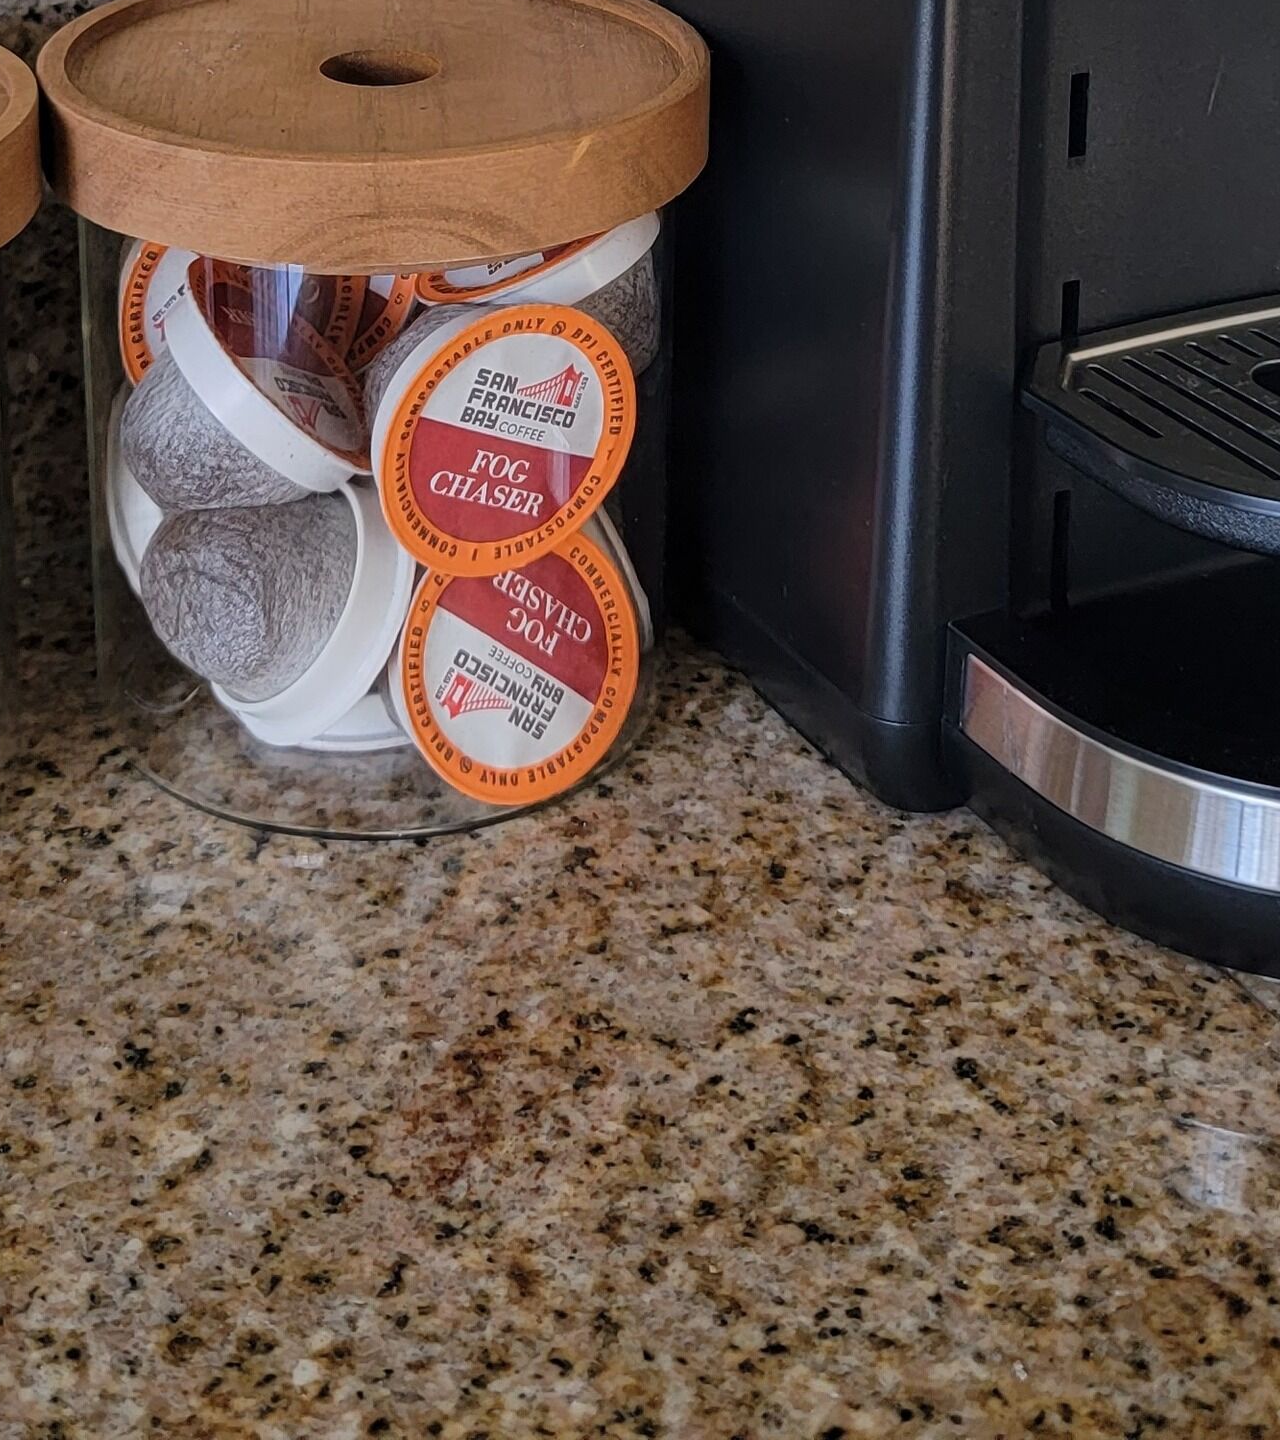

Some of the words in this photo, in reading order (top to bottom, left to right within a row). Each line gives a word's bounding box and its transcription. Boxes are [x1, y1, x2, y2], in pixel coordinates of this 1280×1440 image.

[129, 250, 158, 344] CERTIFIED
[502, 317, 545, 335] ONLY
[572, 327, 598, 350] BPI
[400, 328, 494, 441] COMPOSTABLE
[474, 368, 519, 394] SAN
[596, 350, 624, 436] CERTIFIED
[467, 388, 577, 429] FRANCISCO
[498, 421, 546, 442] COFFEE
[468, 449, 531, 484] FOG
[396, 452, 458, 558] COMMERCIALLY
[430, 470, 545, 518] CHASER
[494, 474, 602, 560] COMPOSTABLE
[492, 570, 592, 642] CHASER
[570, 546, 624, 679] COMMERCIALLY
[506, 607, 561, 657] FOG
[408, 626, 431, 728] CERTIFIED
[453, 648, 558, 724] FRANCISCO
[487, 644, 534, 679] COFFEE
[508, 705, 548, 741] SAN
[527, 686, 618, 784] COMPOSTABLE
[429, 736, 454, 762] BPI
[479, 772, 520, 787] ONLY
